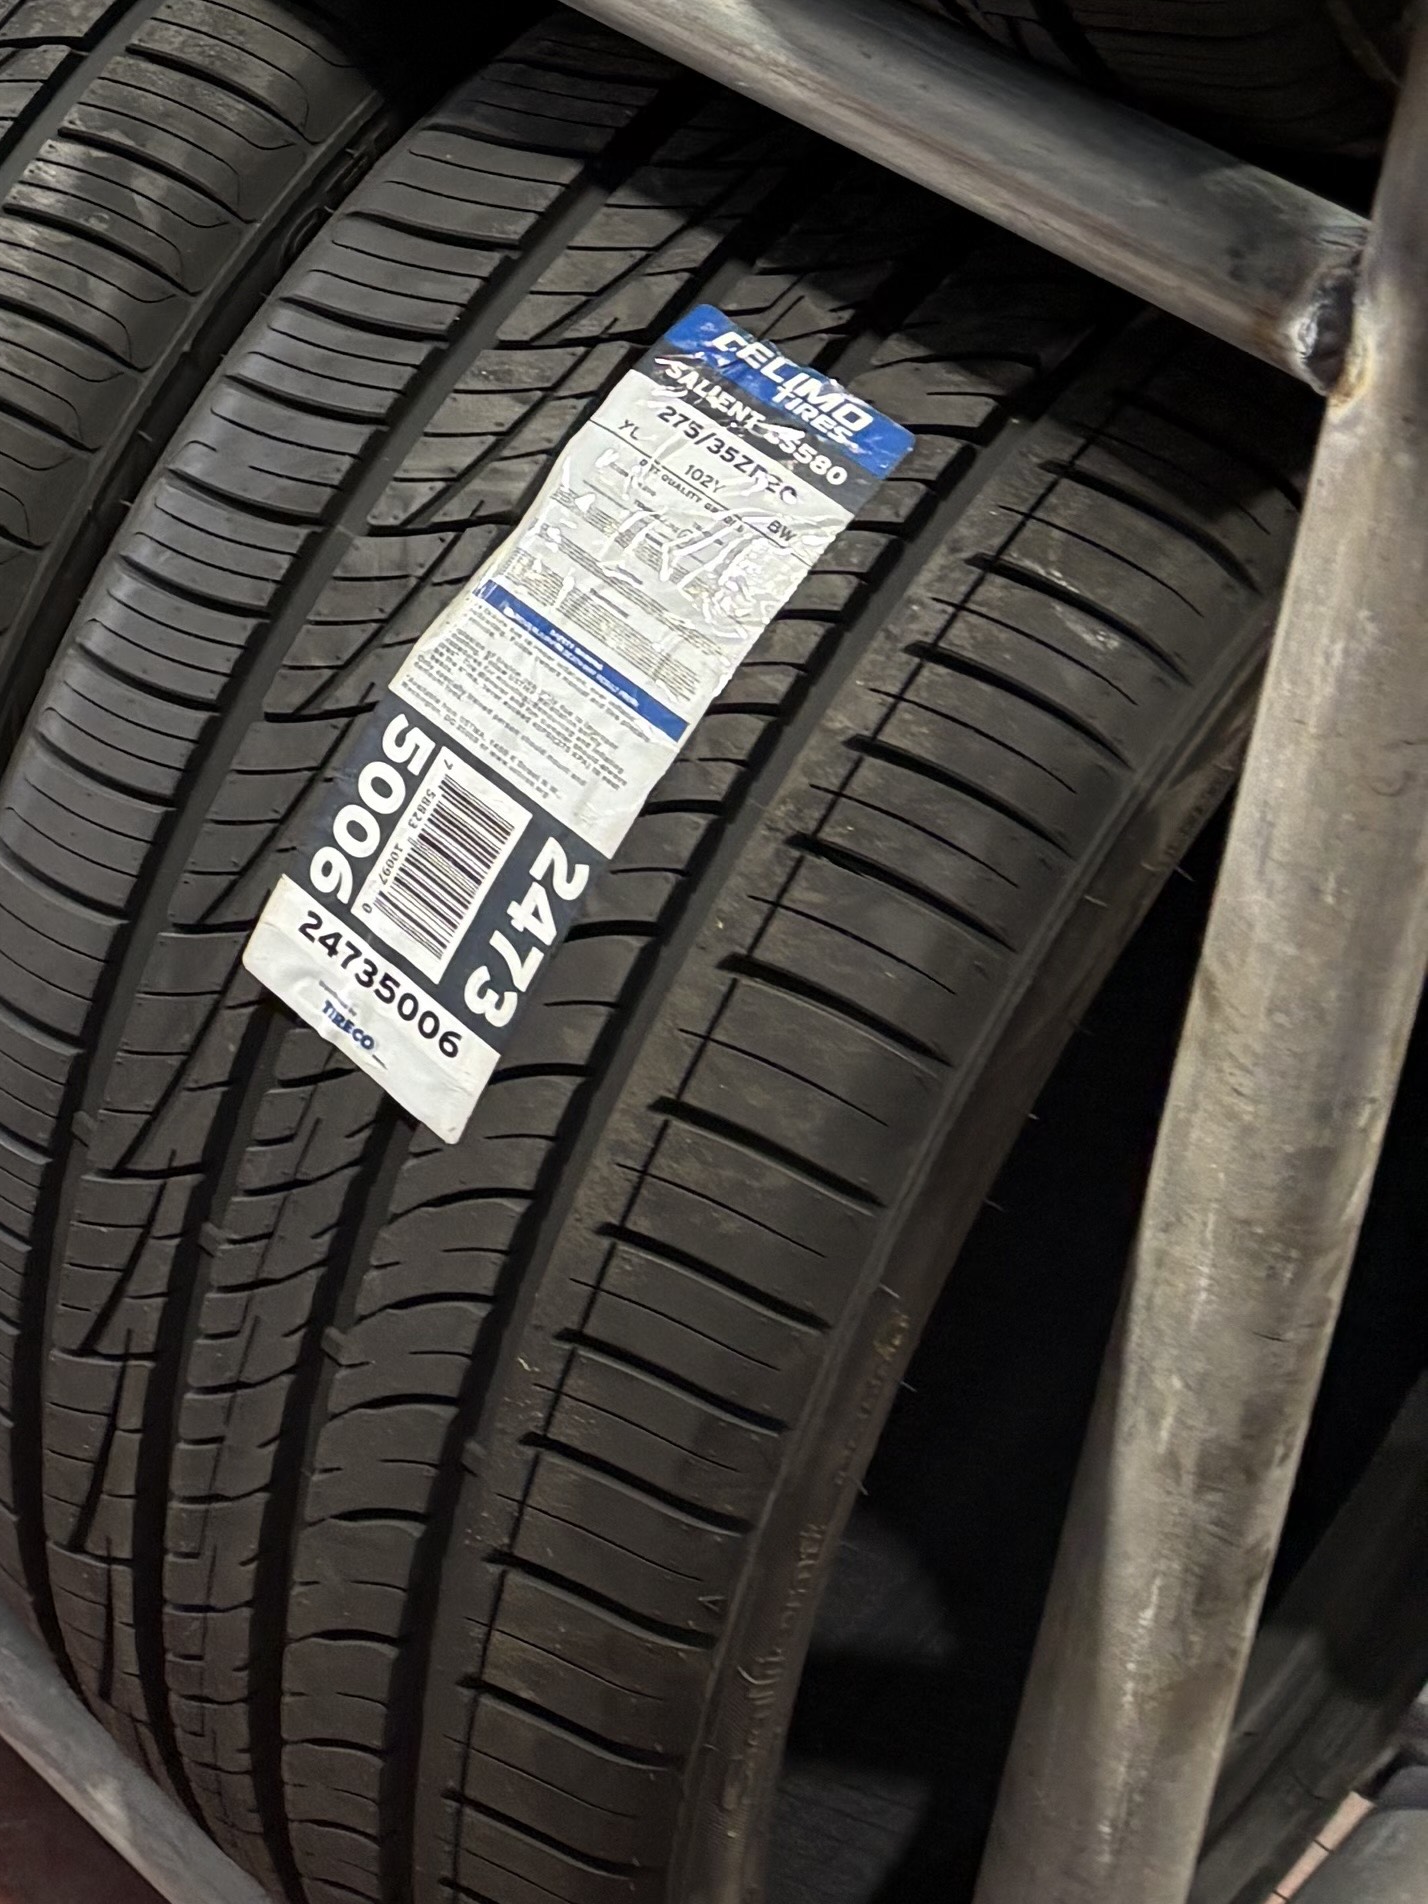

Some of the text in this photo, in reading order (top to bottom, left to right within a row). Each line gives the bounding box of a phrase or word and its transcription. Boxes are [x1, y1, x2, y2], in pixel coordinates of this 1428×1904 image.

[711, 331, 873, 432] CELIMO
[772, 388, 855, 447] TIRES
[684, 464, 727, 493] 102Y
[767, 521, 796, 541] BW
[309, 713, 430, 903] 5006
[463, 836, 589, 1027] 2473
[298, 909, 461, 1059] 24735006
[320, 999, 376, 1052] TIRECO
